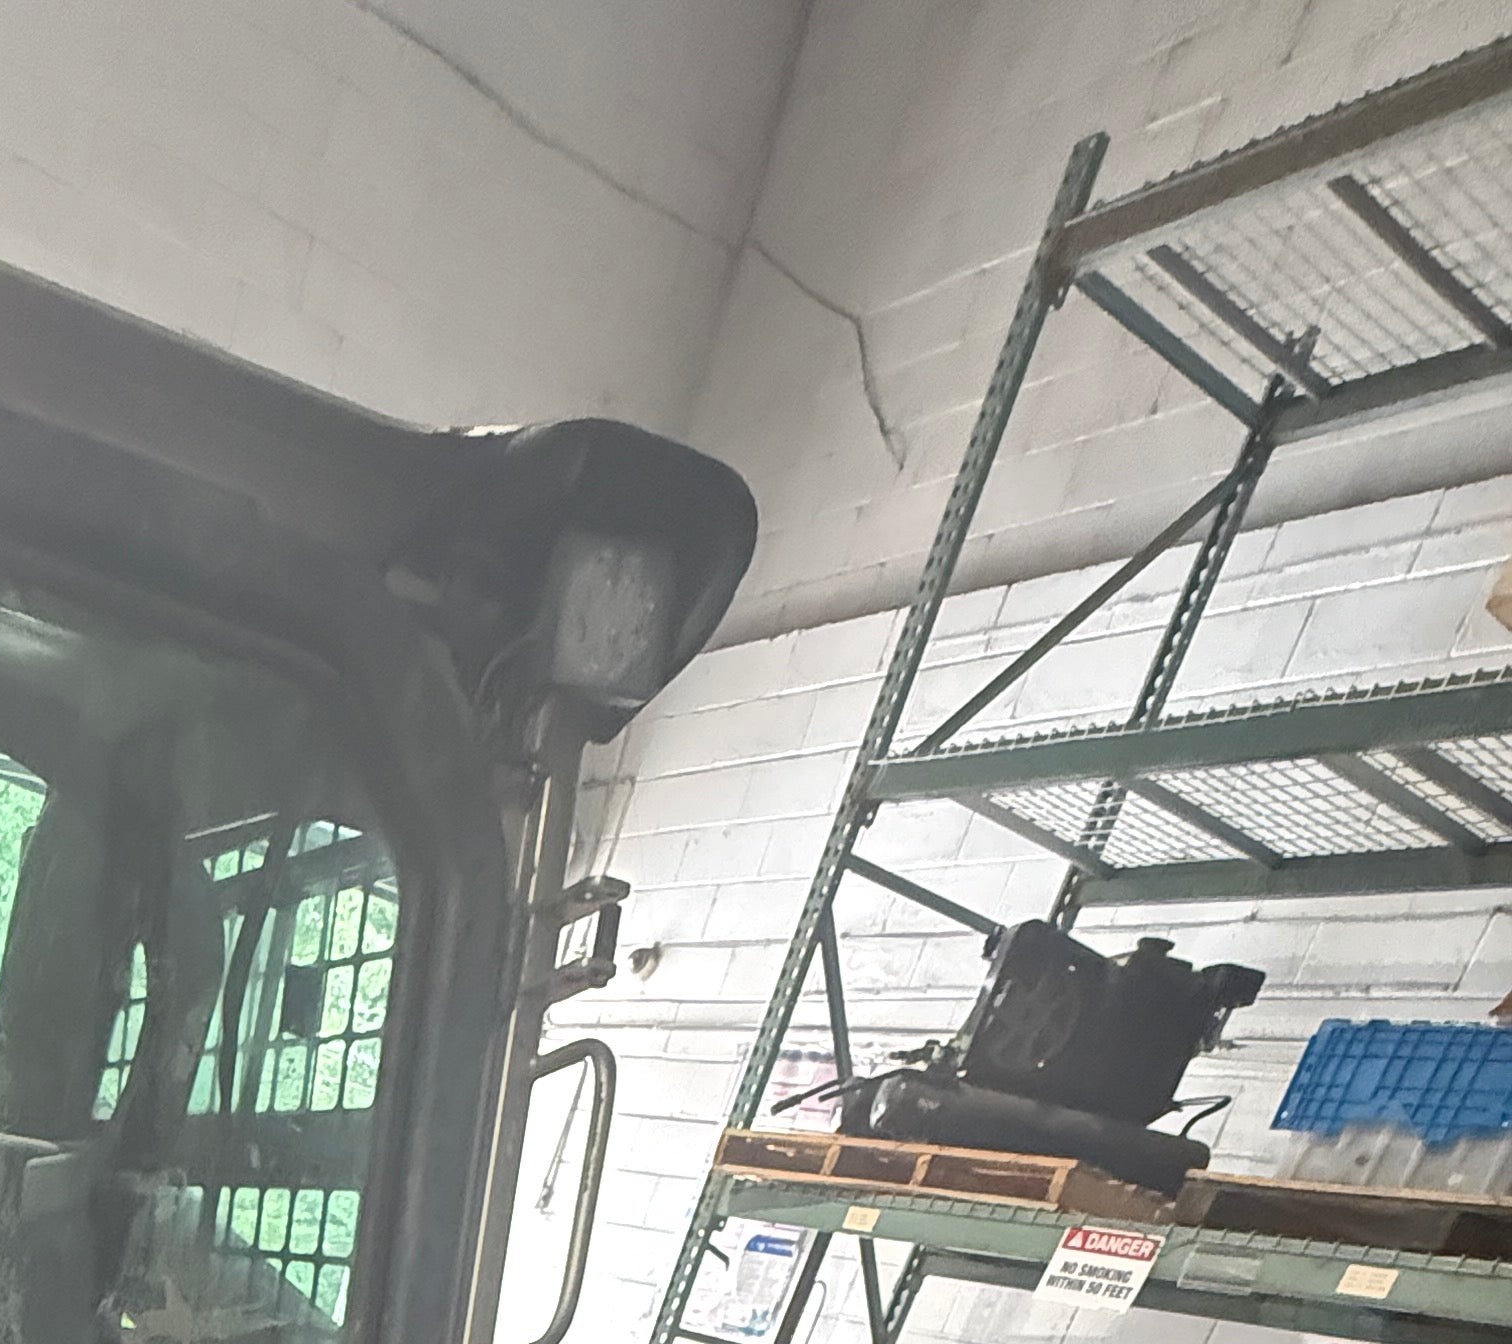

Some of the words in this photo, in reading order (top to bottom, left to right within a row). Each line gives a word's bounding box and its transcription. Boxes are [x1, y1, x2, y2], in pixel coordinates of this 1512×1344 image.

[1083, 1232, 1155, 1258] DANGER
[1059, 1261, 1078, 1274] NO
[1078, 1263, 1133, 1283] SMOKING
[1046, 1275, 1086, 1292] WITHIN
[1085, 1281, 1102, 1295] 50
[1102, 1284, 1133, 1300] FEET
